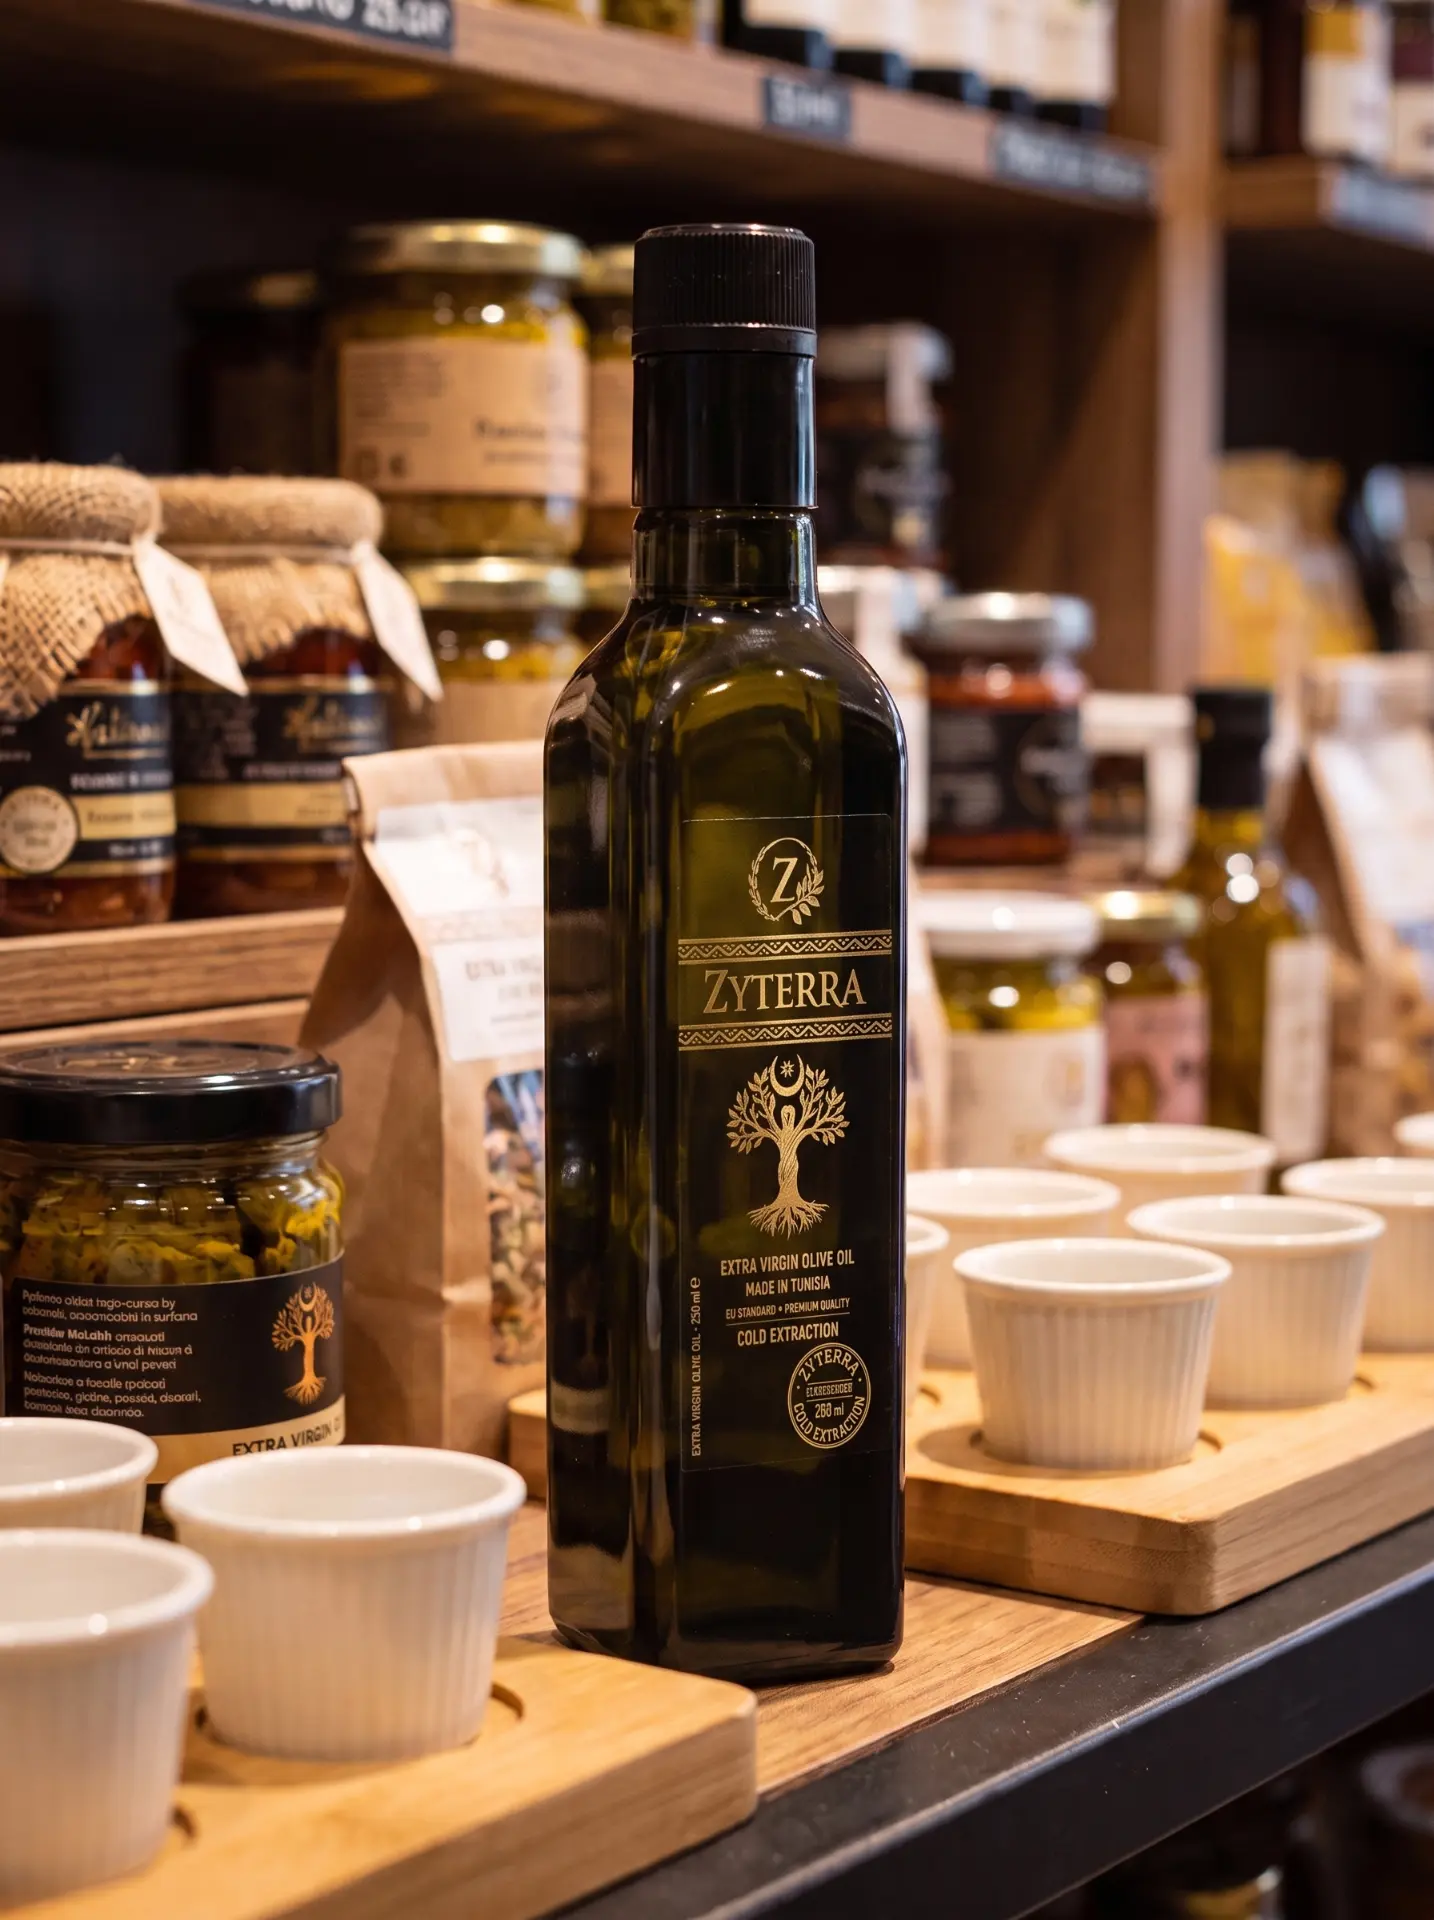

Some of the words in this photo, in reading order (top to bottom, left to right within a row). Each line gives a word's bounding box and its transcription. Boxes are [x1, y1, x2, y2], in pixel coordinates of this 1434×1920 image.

[770, 856, 798, 903] Z
[703, 968, 867, 1014] ZYTERRA
[720, 1257, 757, 1276] EXTRA
[760, 1254, 798, 1273] VIRGIN
[802, 1250, 834, 1269] OLIVE
[836, 1249, 855, 1266] OIL
[690, 1291, 701, 1304] ml
[745, 1279, 775, 1297] MADE
[777, 1279, 788, 1294] IN
[790, 1275, 831, 1293] TUNISIA
[161, 1296, 176, 1310] by
[690, 1305, 701, 1325] 250
[725, 1308, 737, 1320] EU
[737, 1304, 777, 1319] STANDARD
[784, 1300, 820, 1314] PREMIUM
[820, 1298, 851, 1311] QUALITY
[737, 1328, 767, 1347] COLD
[769, 1322, 839, 1344] EXTRACTION
[798, 1348, 860, 1382] ZYTERRA
[793, 1402, 814, 1435] COLD
[812, 1395, 866, 1443] EXTRACTION
[833, 1401, 845, 1417] ml
[232, 1435, 287, 1456] EXTRA
[290, 1420, 332, 1447] VIRGIN
